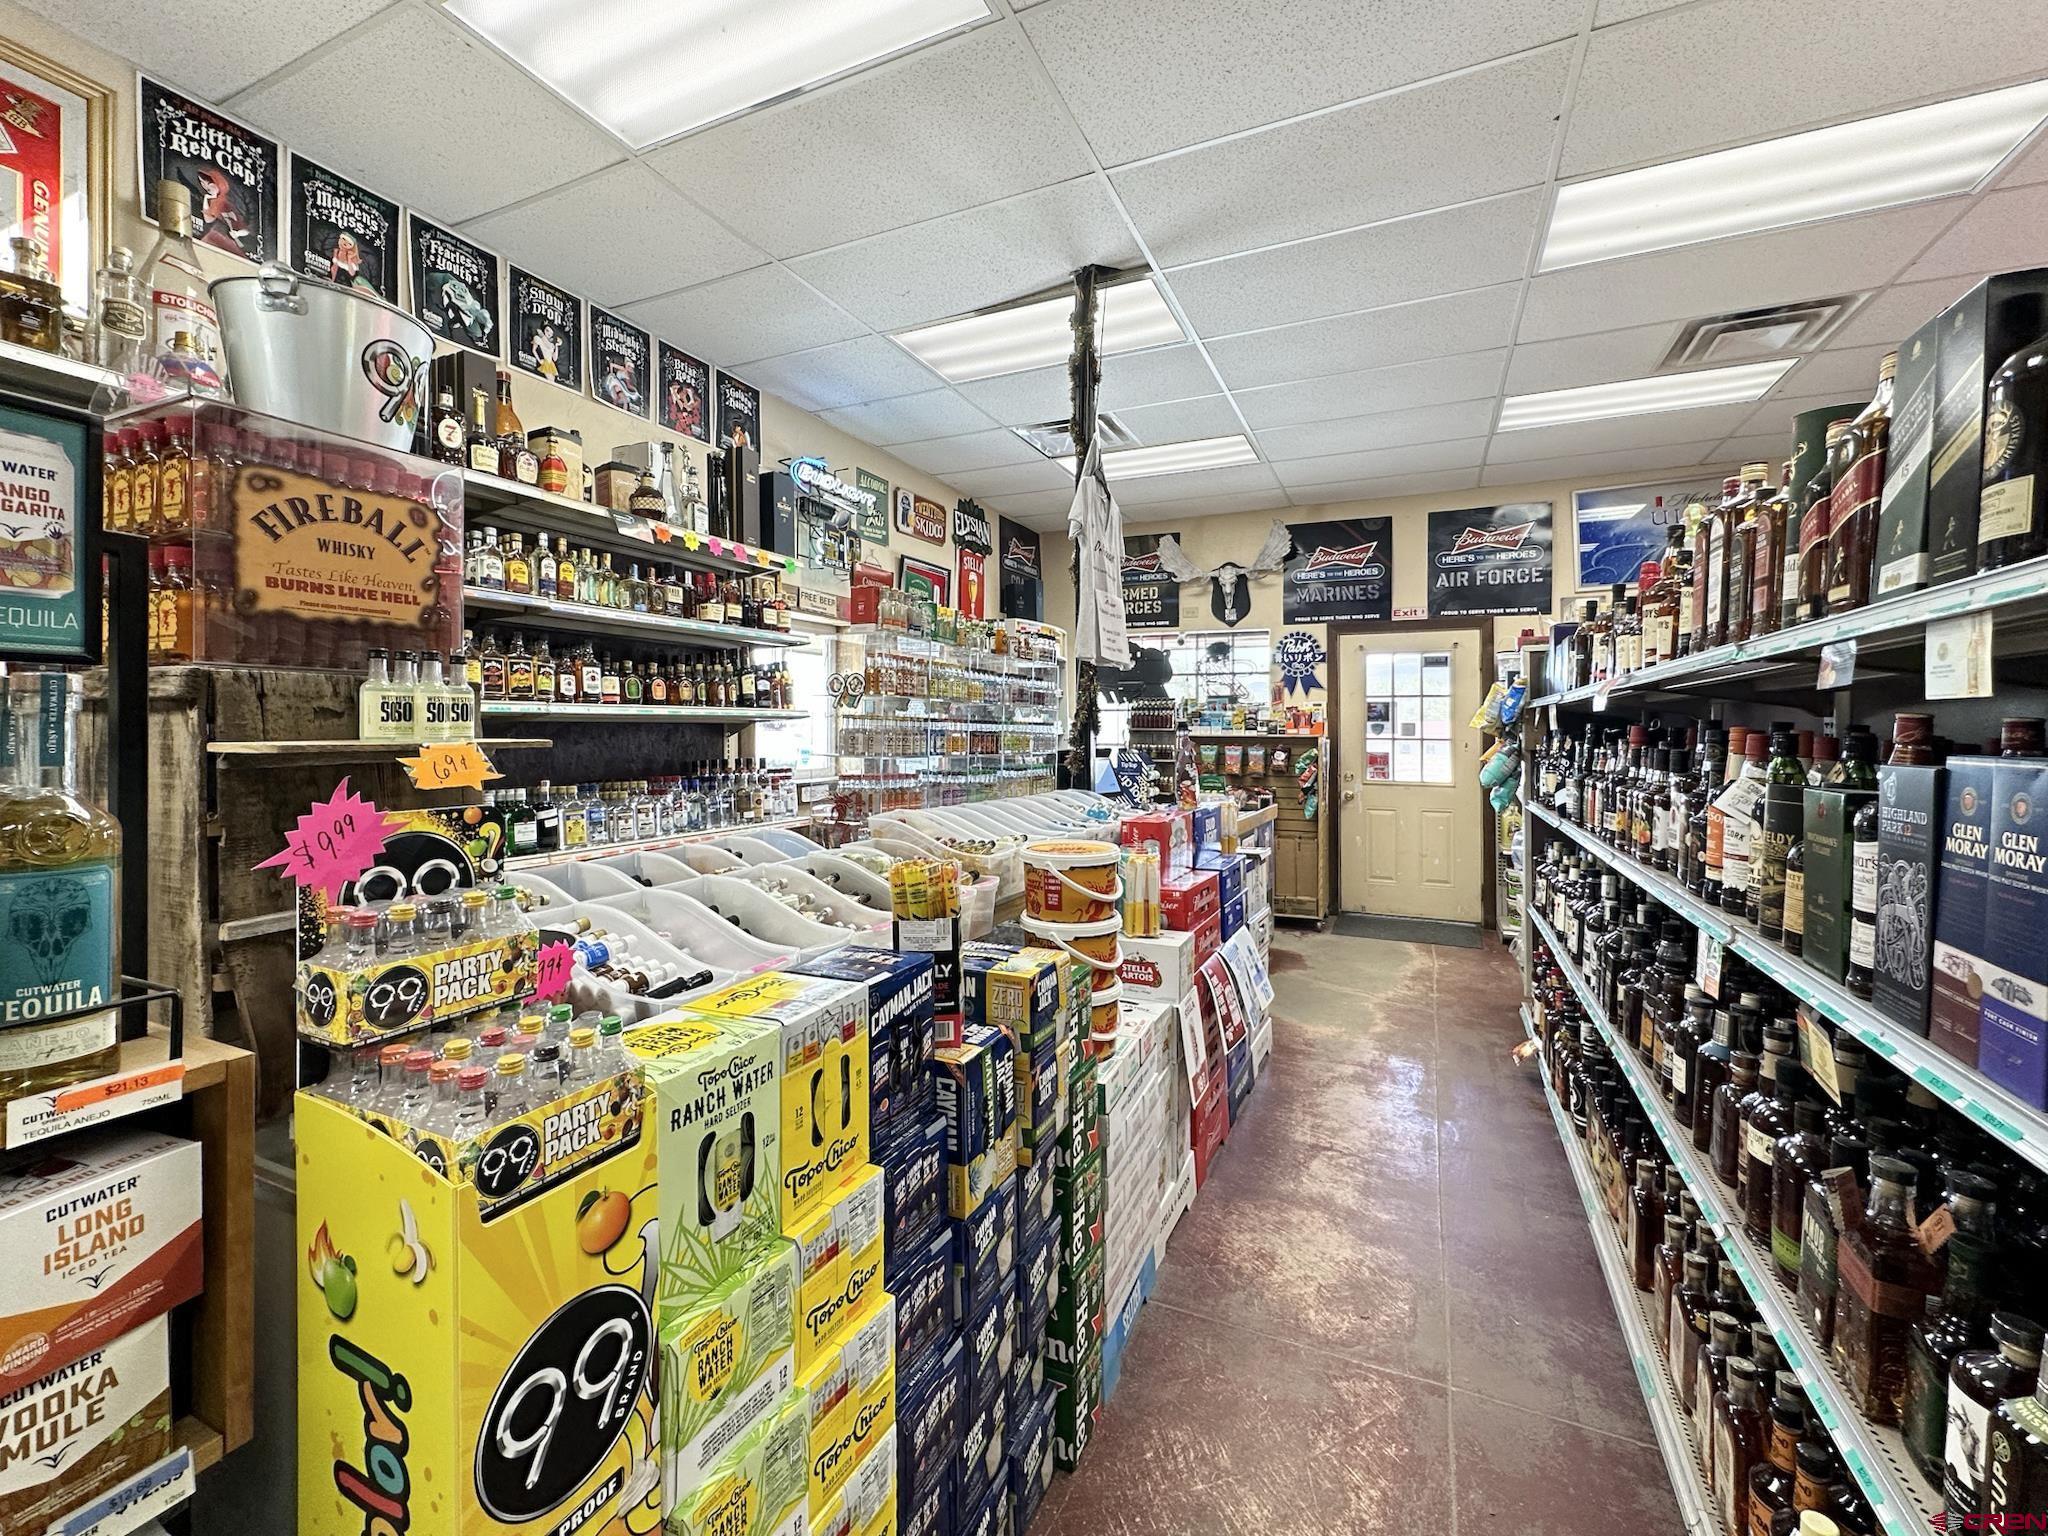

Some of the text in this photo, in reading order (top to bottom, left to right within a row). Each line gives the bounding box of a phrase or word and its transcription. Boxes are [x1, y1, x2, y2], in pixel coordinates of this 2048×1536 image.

[184, 117, 243, 160] Little
[170, 132, 256, 186] Red Cap
[316, 189, 379, 231] Maiden's
[326, 208, 366, 235] Kiss
[430, 239, 478, 274] Fearless
[435, 257, 474, 283] Youth
[529, 286, 564, 312] Snow
[533, 302, 563, 326] Drop
[603, 323, 640, 354] Midnight
[604, 338, 637, 361] Strikes
[673, 358, 697, 380] Briar
[675, 368, 696, 386] Rose
[0, 460, 56, 481] WATER
[0, 481, 50, 502] ANGO
[251, 494, 424, 564] FIREBALL
[915, 517, 944, 538] SKIDOO
[954, 511, 991, 546] ELYSIAN
[1454, 528, 1533, 547] Budweiser
[317, 537, 376, 560] WHISKY
[1311, 547, 1373, 563] Budweiser
[1442, 554, 1475, 564] HERE'S
[1496, 550, 1537, 561] HEROES
[272, 560, 416, 594] Tastes Like Heaven,
[963, 556, 983, 575] STELLA
[1139, 573, 1168, 582] HEROES
[1297, 570, 1325, 579] HERE'S
[1344, 568, 1379, 577] HEROES
[1436, 567, 1544, 589] AIR FORCE
[265, 575, 421, 606] BURNS LIKE HELL
[801, 591, 817, 600] FREE
[1123, 587, 1158, 600] RMED
[1297, 584, 1380, 603] MARINES
[0, 607, 78, 630] EQUILA
[1125, 600, 1162, 615] RCES
[1393, 608, 1418, 618] Exit
[1283, 640, 1313, 655] Pabst
[1881, 806, 1927, 824] HIGHLAND
[1881, 819, 1912, 835] PARK 12
[293, 813, 356, 869] $9.99
[1727, 829, 1745, 842] CORK
[1952, 822, 1983, 842] GLEN
[2002, 831, 2038, 853] GLEN
[1945, 836, 1989, 860] MORAY
[1993, 847, 2047, 874] MORAY
[434, 949, 503, 984] PARTY
[1121, 963, 1153, 974] STELLA
[1121, 972, 1154, 983] ARTOIS
[16, 979, 81, 997] CUTWATER
[433, 975, 493, 1009] PACK
[992, 988, 1023, 1003] ZERO
[1037, 969, 1058, 996] CAYMAN
[0, 985, 103, 1022] EQUILA
[371, 976, 423, 1020] 99
[872, 968, 933, 1037] CAYMAN JACK
[1038, 990, 1053, 1012] JACK
[992, 1004, 1024, 1021] SUGAR
[1984, 1009, 2038, 1041] PORT CASK FINISH
[104, 1076, 149, 1097] $21.13
[698, 1054, 757, 1093] Topo Chico
[141, 1093, 173, 1106] 750ML
[670, 1061, 774, 1132] RANCH WATER
[23, 1109, 110, 1140] TEQUILA ANEJO
[544, 1092, 612, 1138] PARTY
[704, 1096, 752, 1130] HARD SELTZER
[795, 1107, 804, 1119] 12
[936, 1077, 958, 1151] CAYMAN
[545, 1118, 602, 1165] PACK
[481, 1134, 534, 1188] 99
[784, 1160, 823, 1197] Topo
[822, 1133, 860, 1172] Chico
[46, 1178, 138, 1223] CUTWATER
[57, 1197, 132, 1246] LONG
[44, 1214, 145, 1276] ISLAND
[61, 1245, 128, 1280] ICED TEA
[806, 1294, 845, 1337] Topo
[842, 1260, 881, 1304] Chico
[693, 1316, 739, 1355] Topo Chico
[0, 1345, 50, 1374] WINNING
[3, 1337, 45, 1364] AWARD
[697, 1334, 733, 1373] RANCH
[0, 1353, 102, 1409] CUTWATER
[698, 1352, 734, 1386] WATER
[779, 1364, 788, 1378] 12
[613, 1349, 643, 1419] BRAND
[495, 1316, 635, 1490] 99
[0, 1396, 105, 1472] MULE
[814, 1392, 891, 1480] Topo Chico
[559, 1478, 619, 1536] PROOF
[707, 1477, 752, 1525] Topo Chico
[711, 1499, 747, 1536] RANCH
